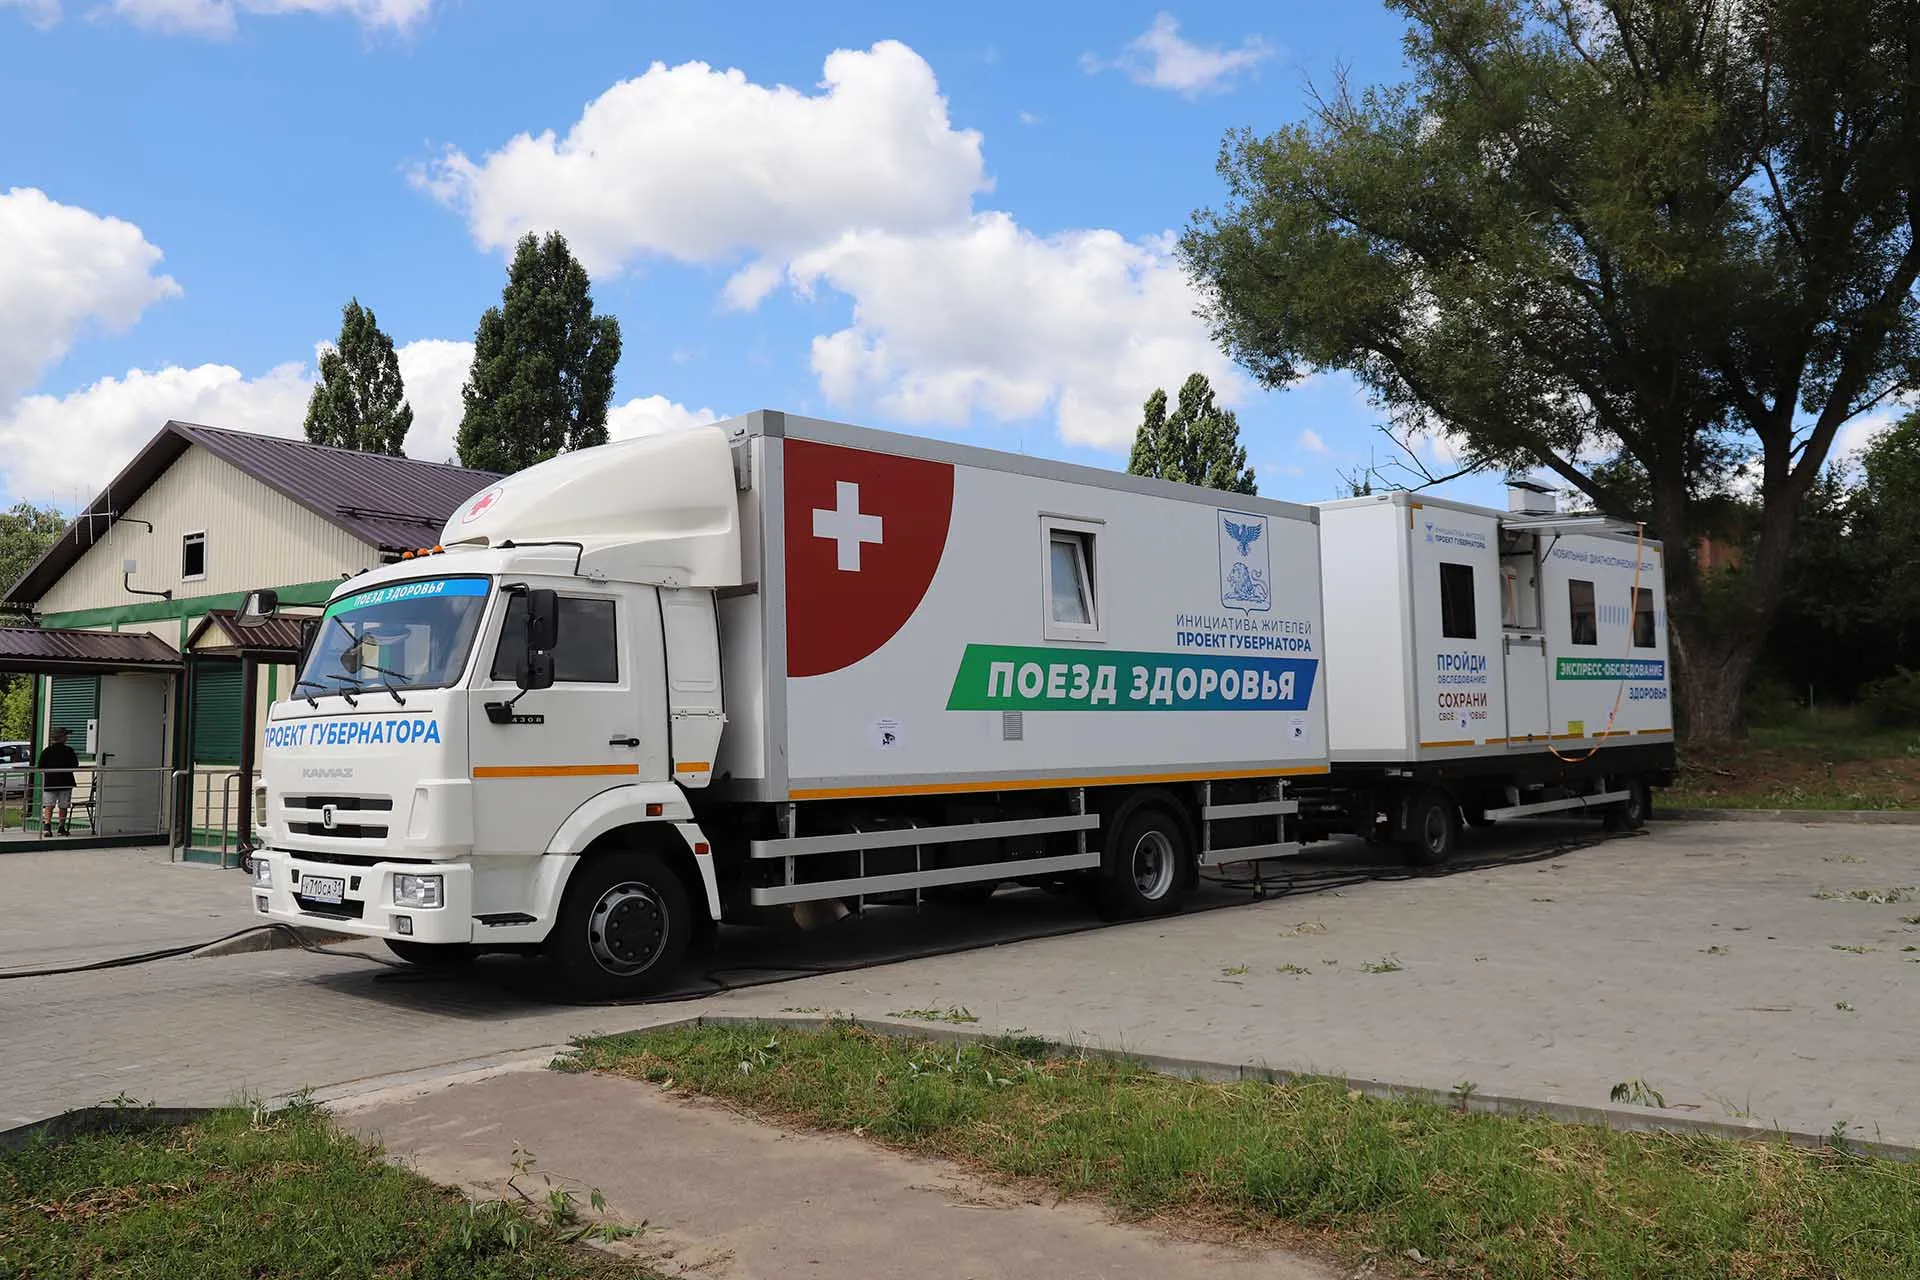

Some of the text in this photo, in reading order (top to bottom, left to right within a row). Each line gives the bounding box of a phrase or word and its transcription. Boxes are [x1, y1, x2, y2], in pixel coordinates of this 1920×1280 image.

[353, 582, 445, 606] ПОЕЗД ЗДОРОВЬЯ
[1176, 614, 1312, 635] ИНИЦИАТИВА ЖИТЕЛЕЙ
[1177, 631, 1312, 652] ПРОЕКТ ГУБЕРНАТОРА
[1437, 650, 1487, 674] ПРОЙДИ
[1560, 662, 1663, 678] ЭКСПРЕСС-ОБСЛЕДОВАНИЕ
[987, 661, 1295, 705] ПОЕЗД ЗДОРОВЬЯ
[1438, 692, 1487, 708] СОХРАНИ
[1628, 687, 1667, 701] ЗДОРОВЬЯ
[309, 719, 441, 746] ГУБЕРНАТОРА
[302, 767, 353, 779] KAMAZ
